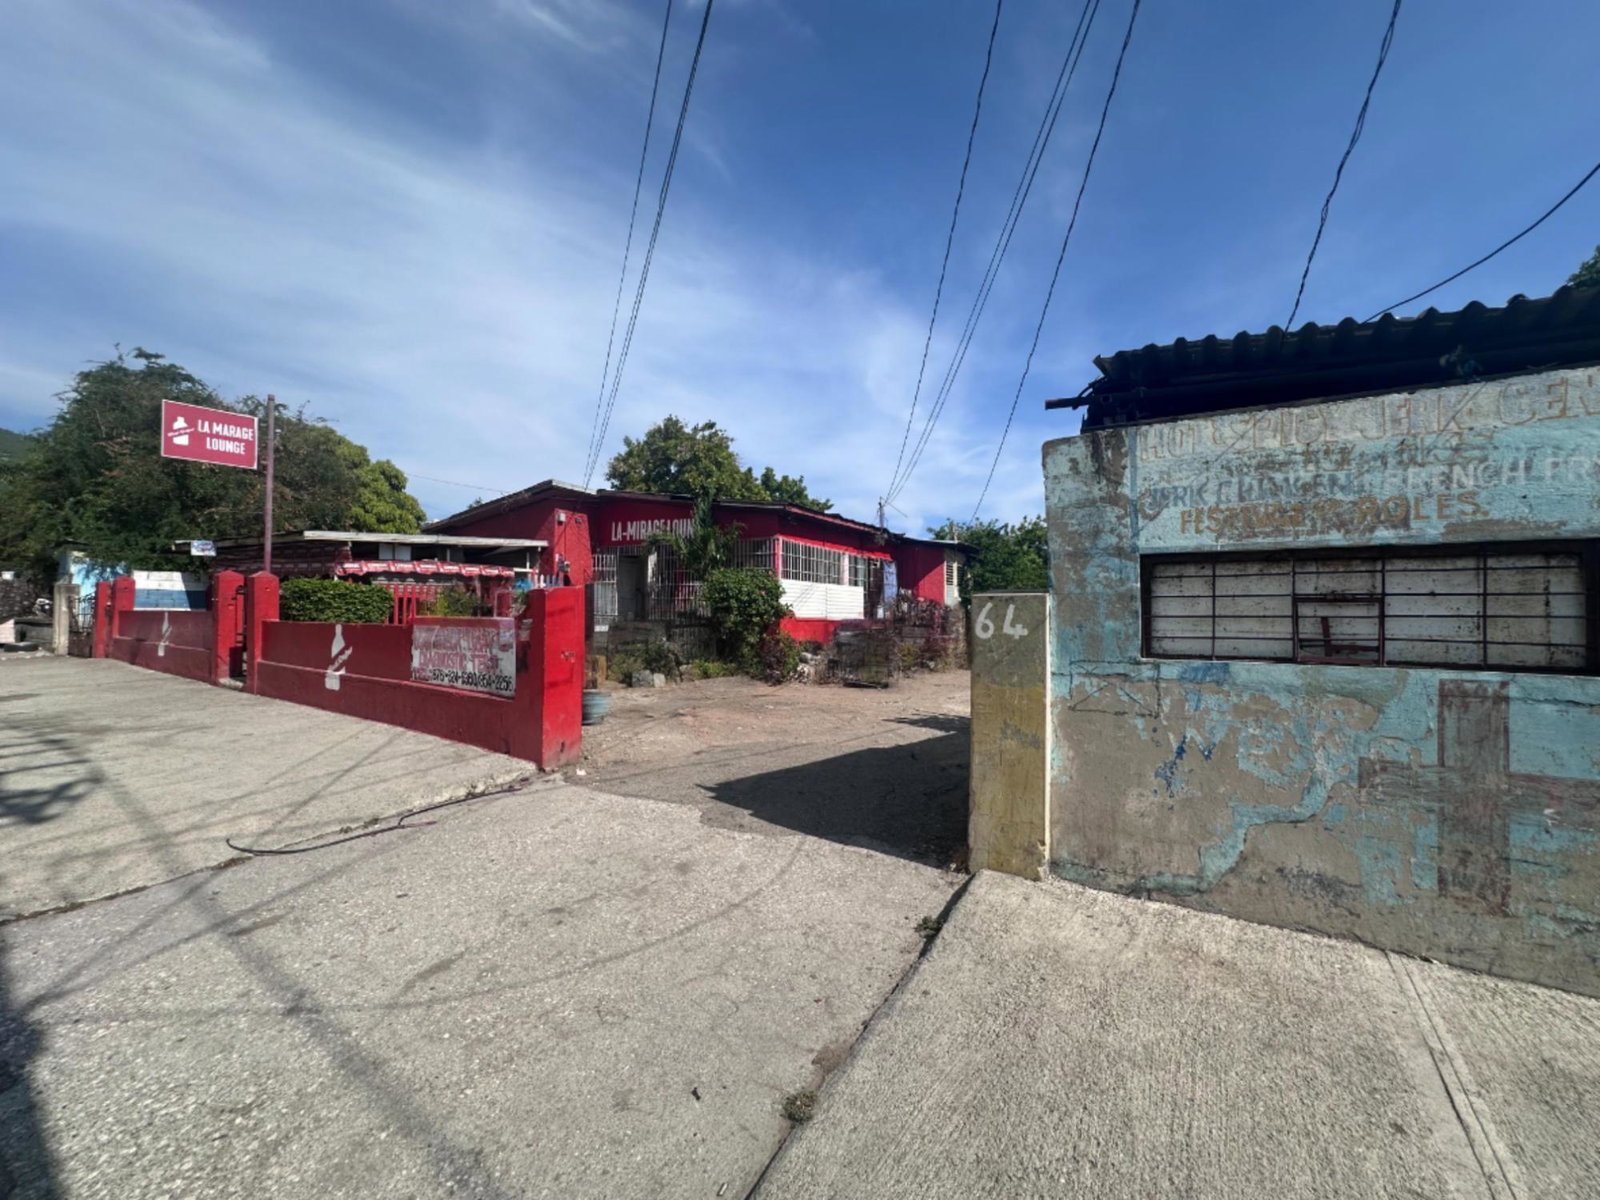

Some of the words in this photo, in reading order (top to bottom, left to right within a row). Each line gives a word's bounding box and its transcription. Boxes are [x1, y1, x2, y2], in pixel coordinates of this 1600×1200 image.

[197, 419, 211, 433] LA
[212, 422, 254, 441] MARAGE
[205, 437, 246, 455] LOUNGE
[974, 601, 1029, 640] 64
